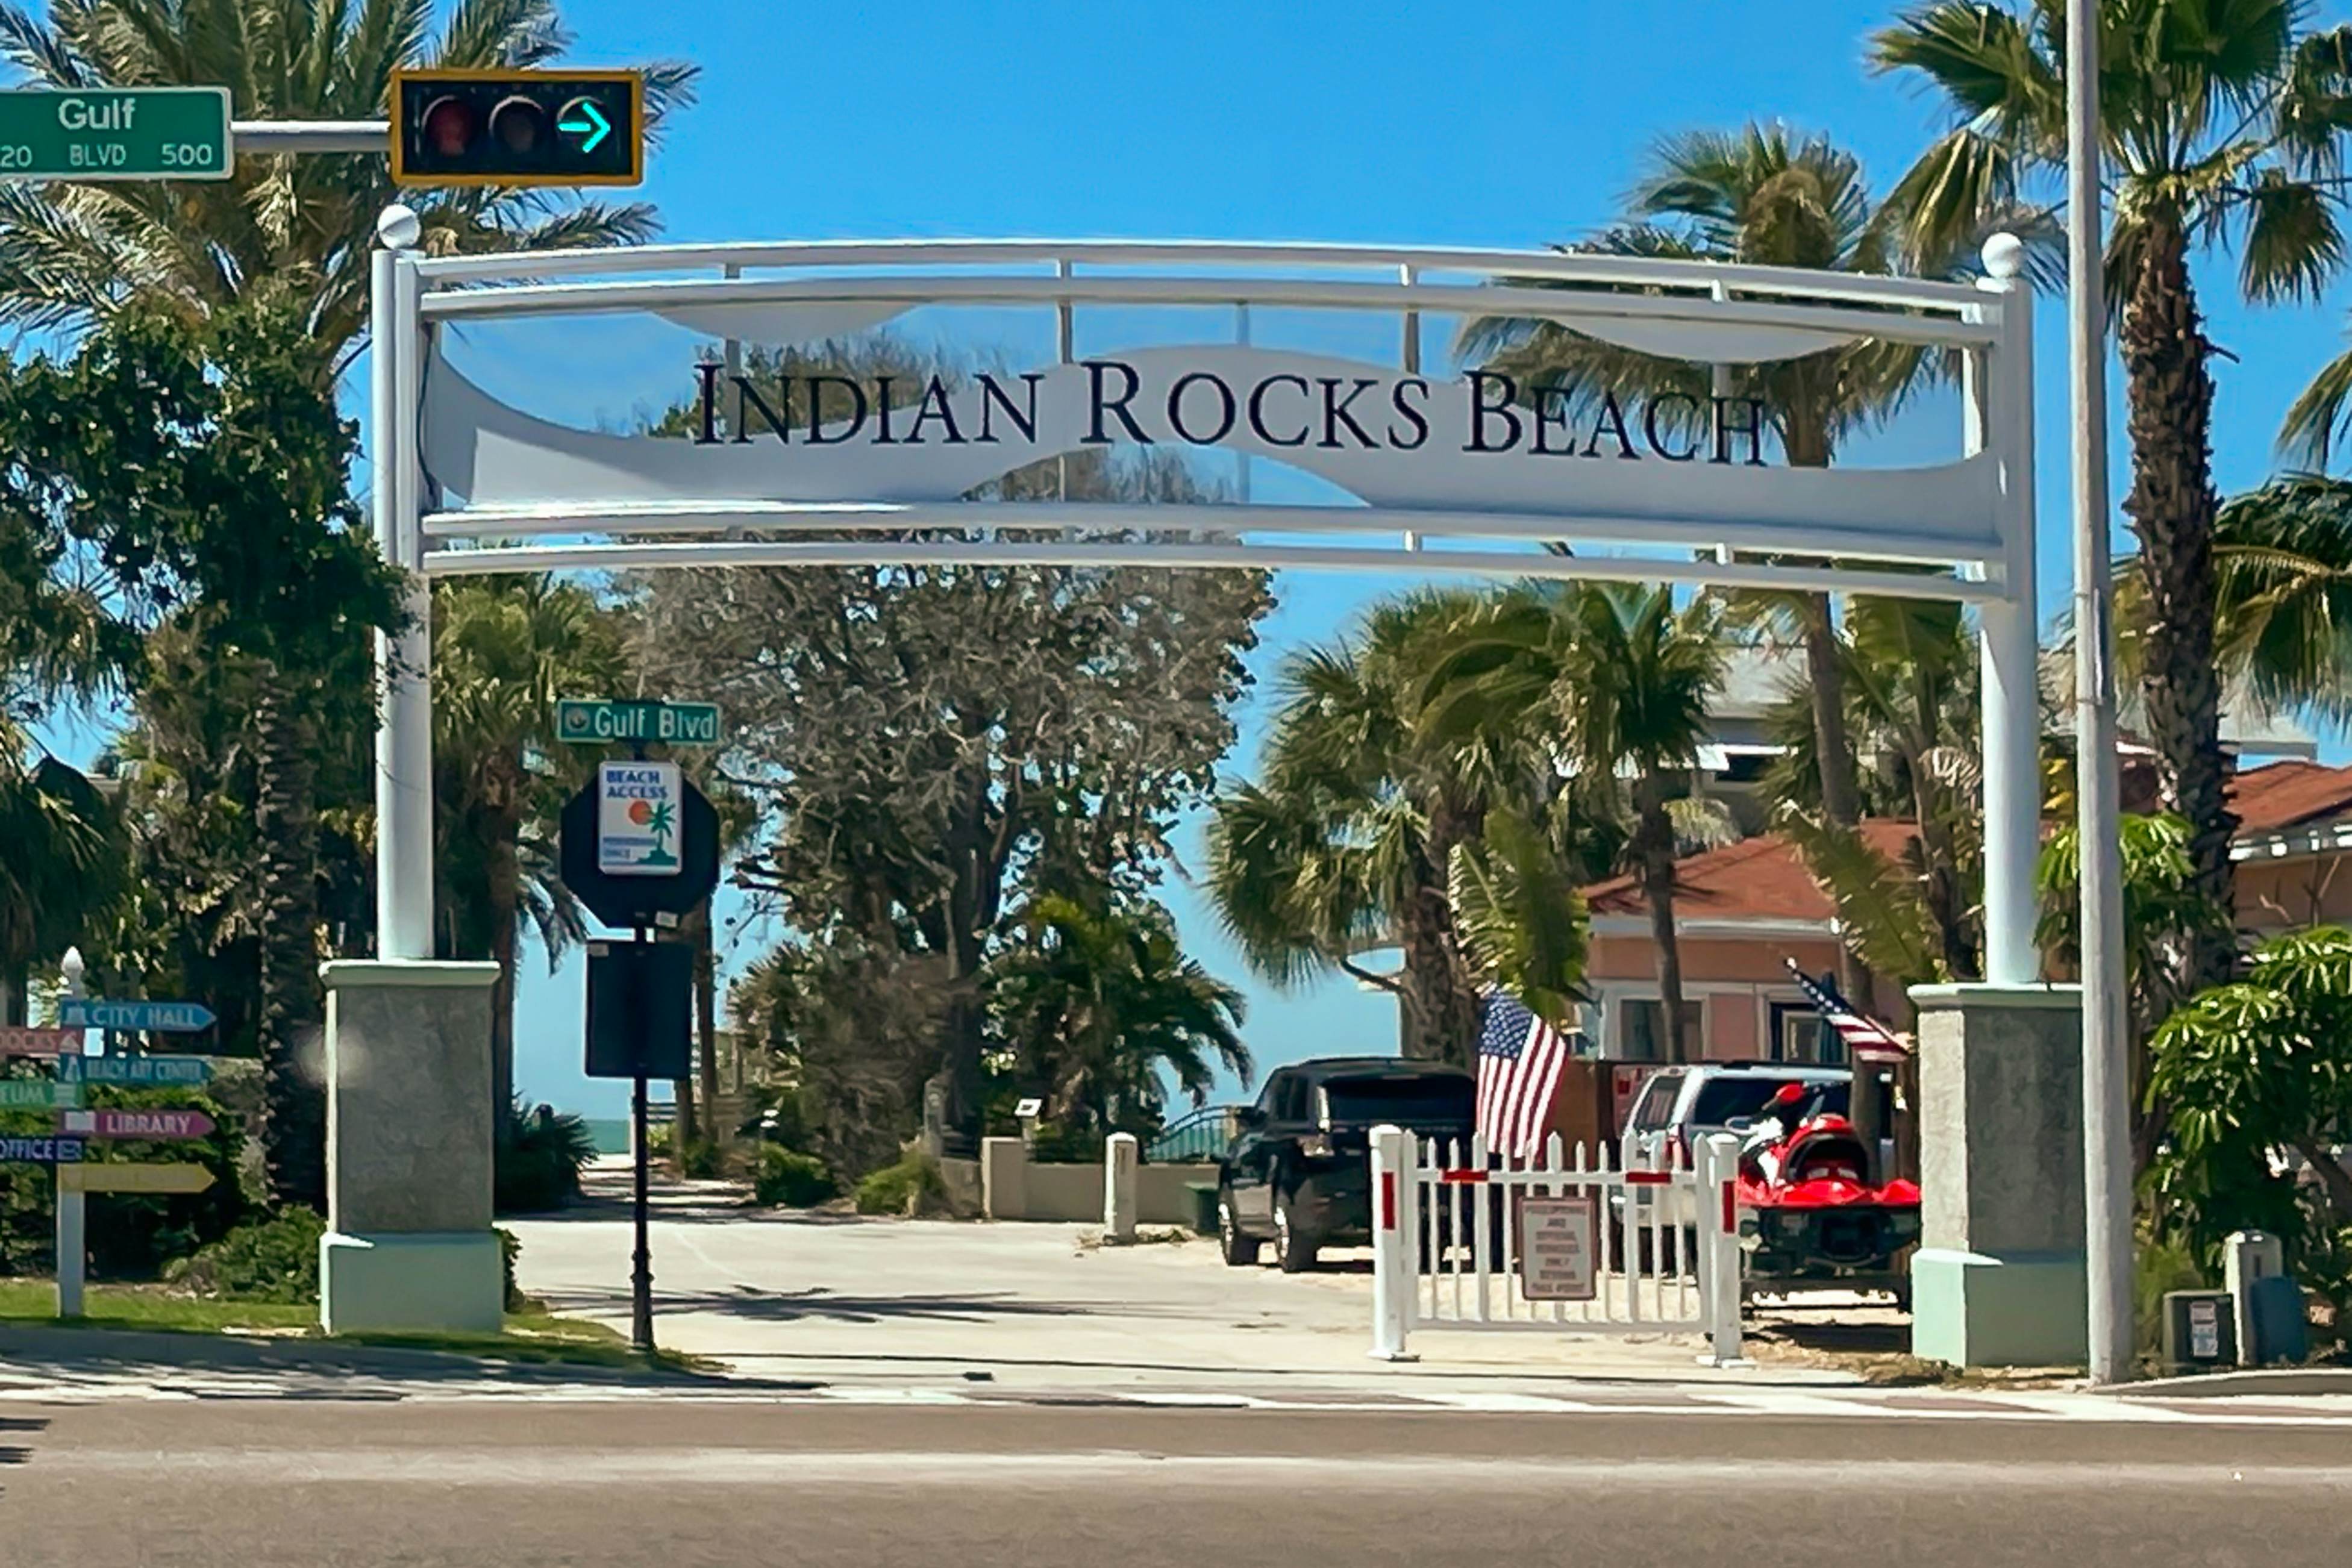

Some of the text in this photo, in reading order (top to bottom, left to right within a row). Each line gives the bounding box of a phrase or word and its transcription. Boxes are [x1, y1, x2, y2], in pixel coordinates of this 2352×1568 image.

[58, 98, 137, 130] Gulf
[69, 144, 127, 166] BLVD
[161, 143, 213, 166] 500
[693, 361, 1768, 467] INDIAN ROCKS BEACH
[595, 707, 713, 739] Gulf Blvd
[606, 770, 660, 783] BEACH
[606, 787, 668, 799] ACCESS
[92, 1007, 194, 1025] CITY HALL
[106, 1115, 191, 1134] LIBRARY
[0, 1139, 53, 1160] OFFICE
